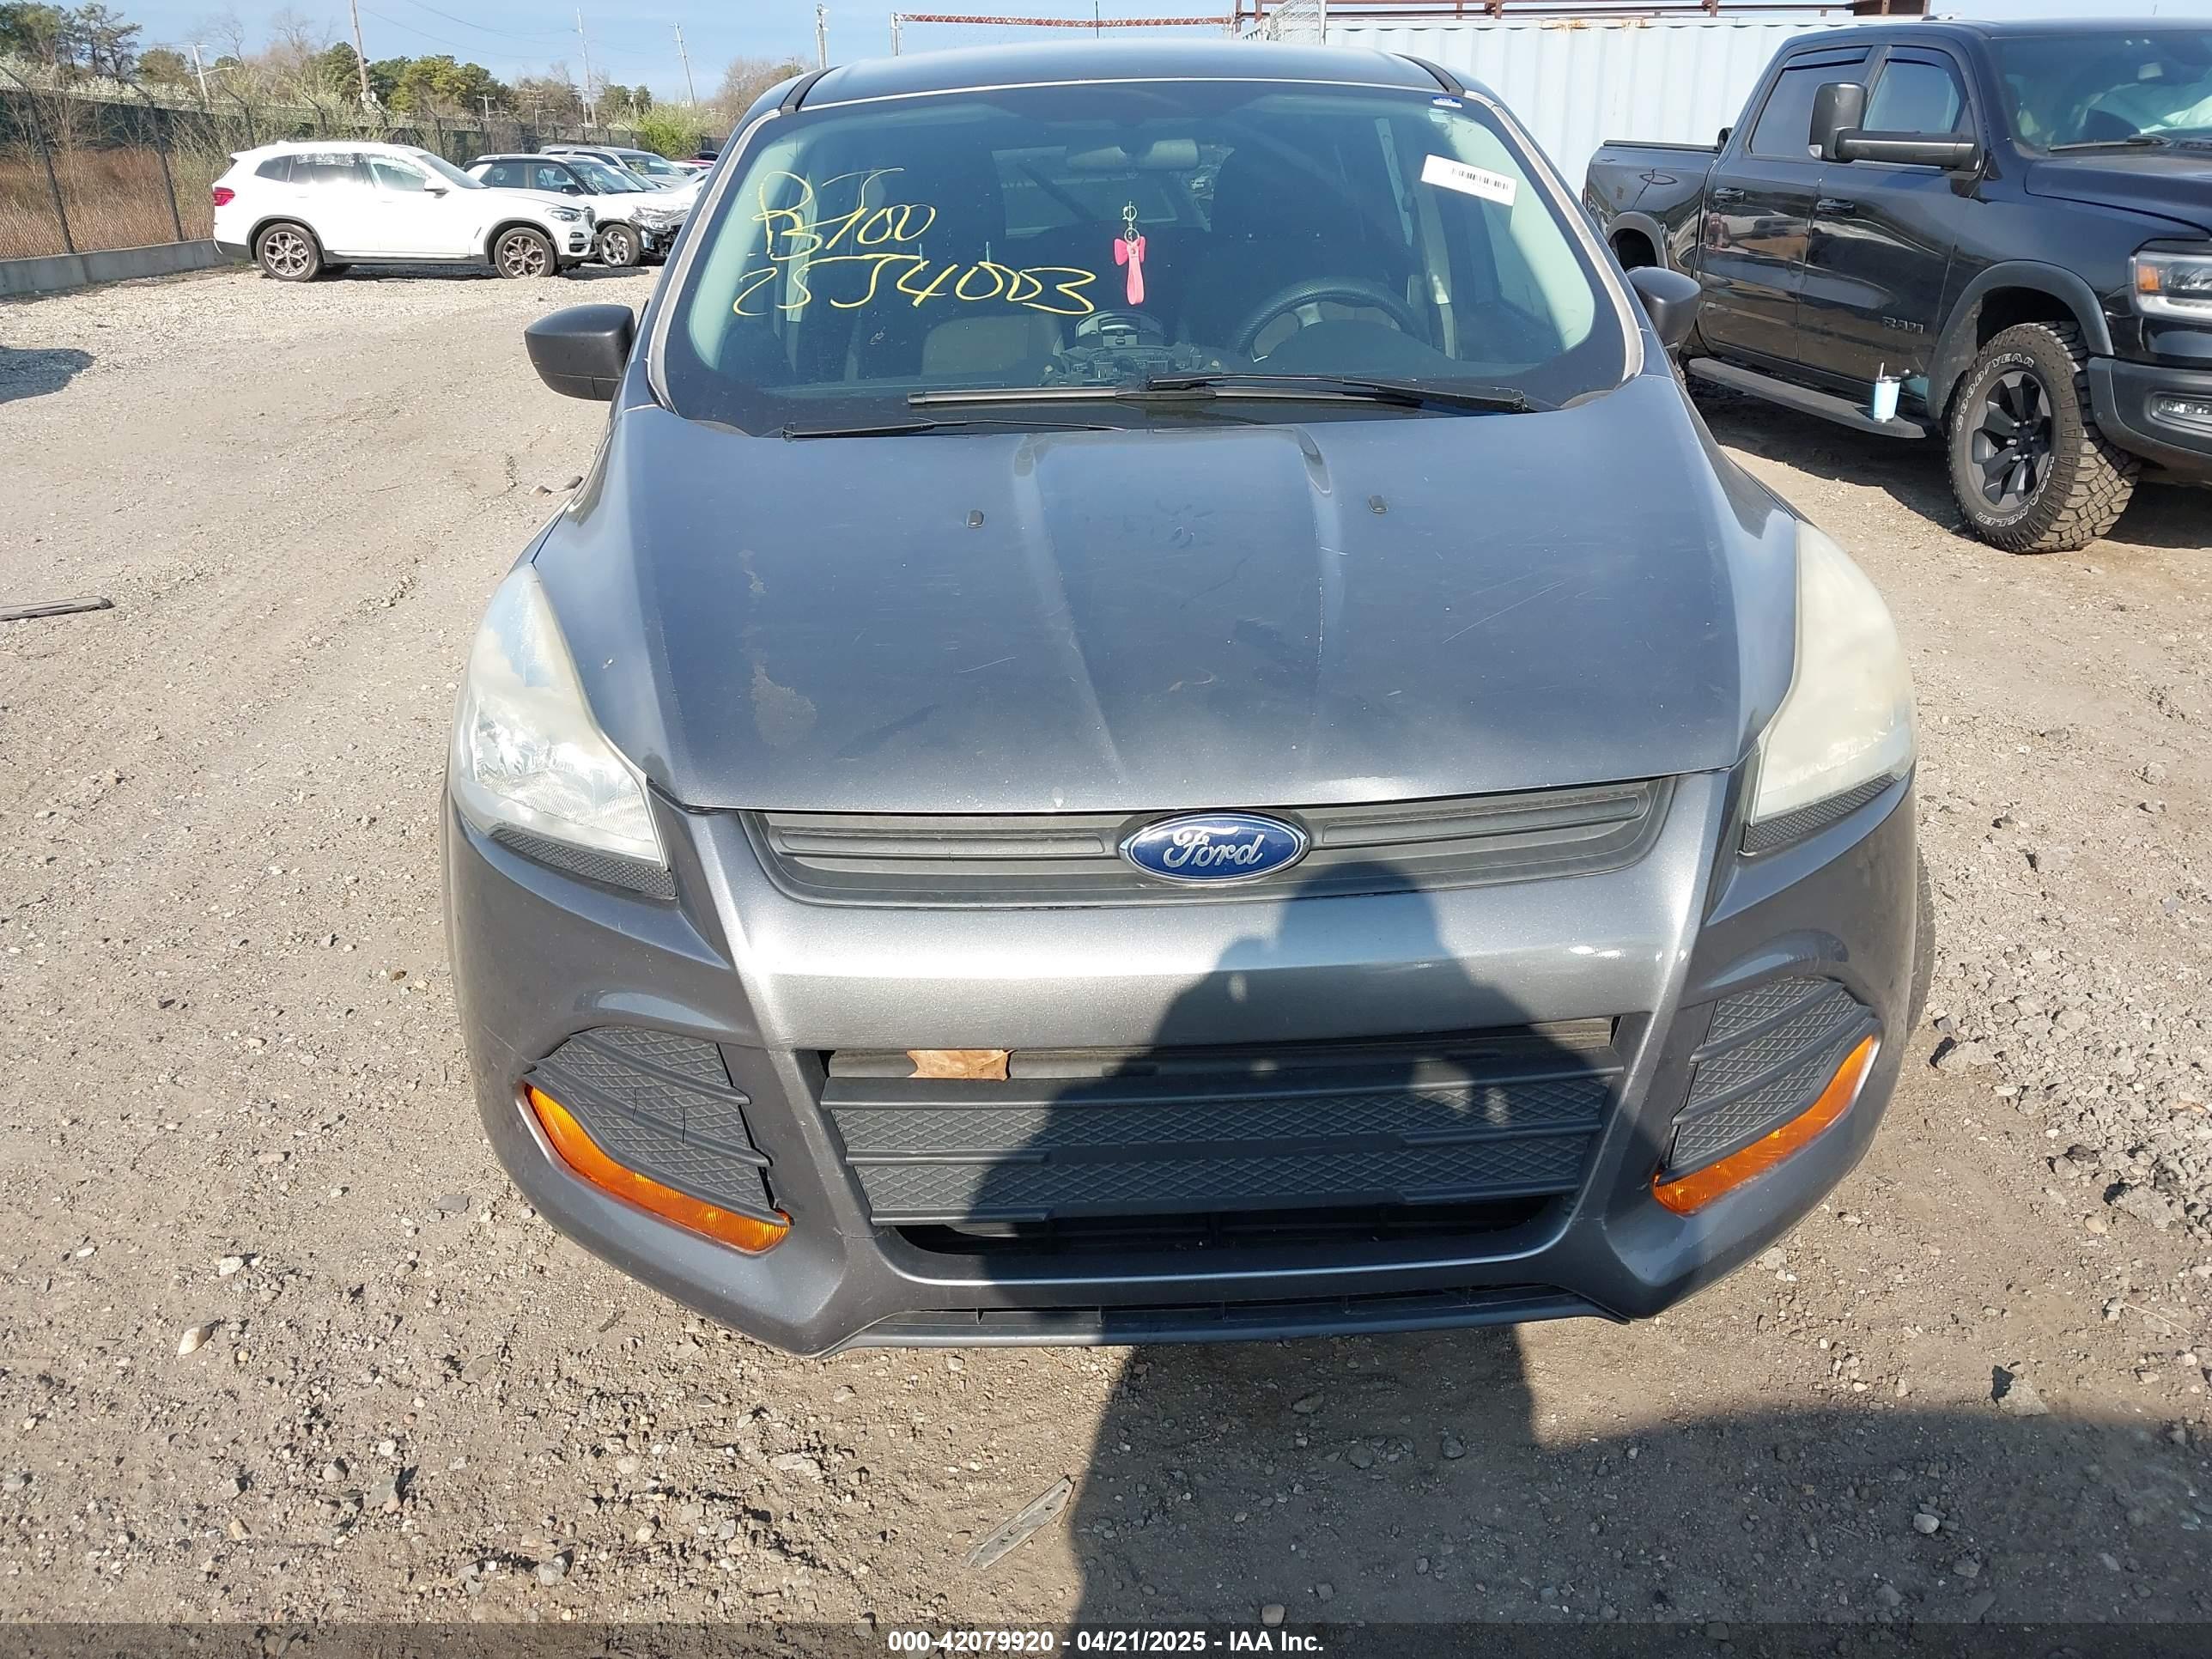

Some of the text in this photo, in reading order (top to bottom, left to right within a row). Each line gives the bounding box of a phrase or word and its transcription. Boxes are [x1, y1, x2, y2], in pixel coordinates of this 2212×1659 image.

[1881, 316, 1924, 336] RAM
[1955, 352, 2034, 432] GOODYEAR
[1163, 825, 1265, 868] Ford
